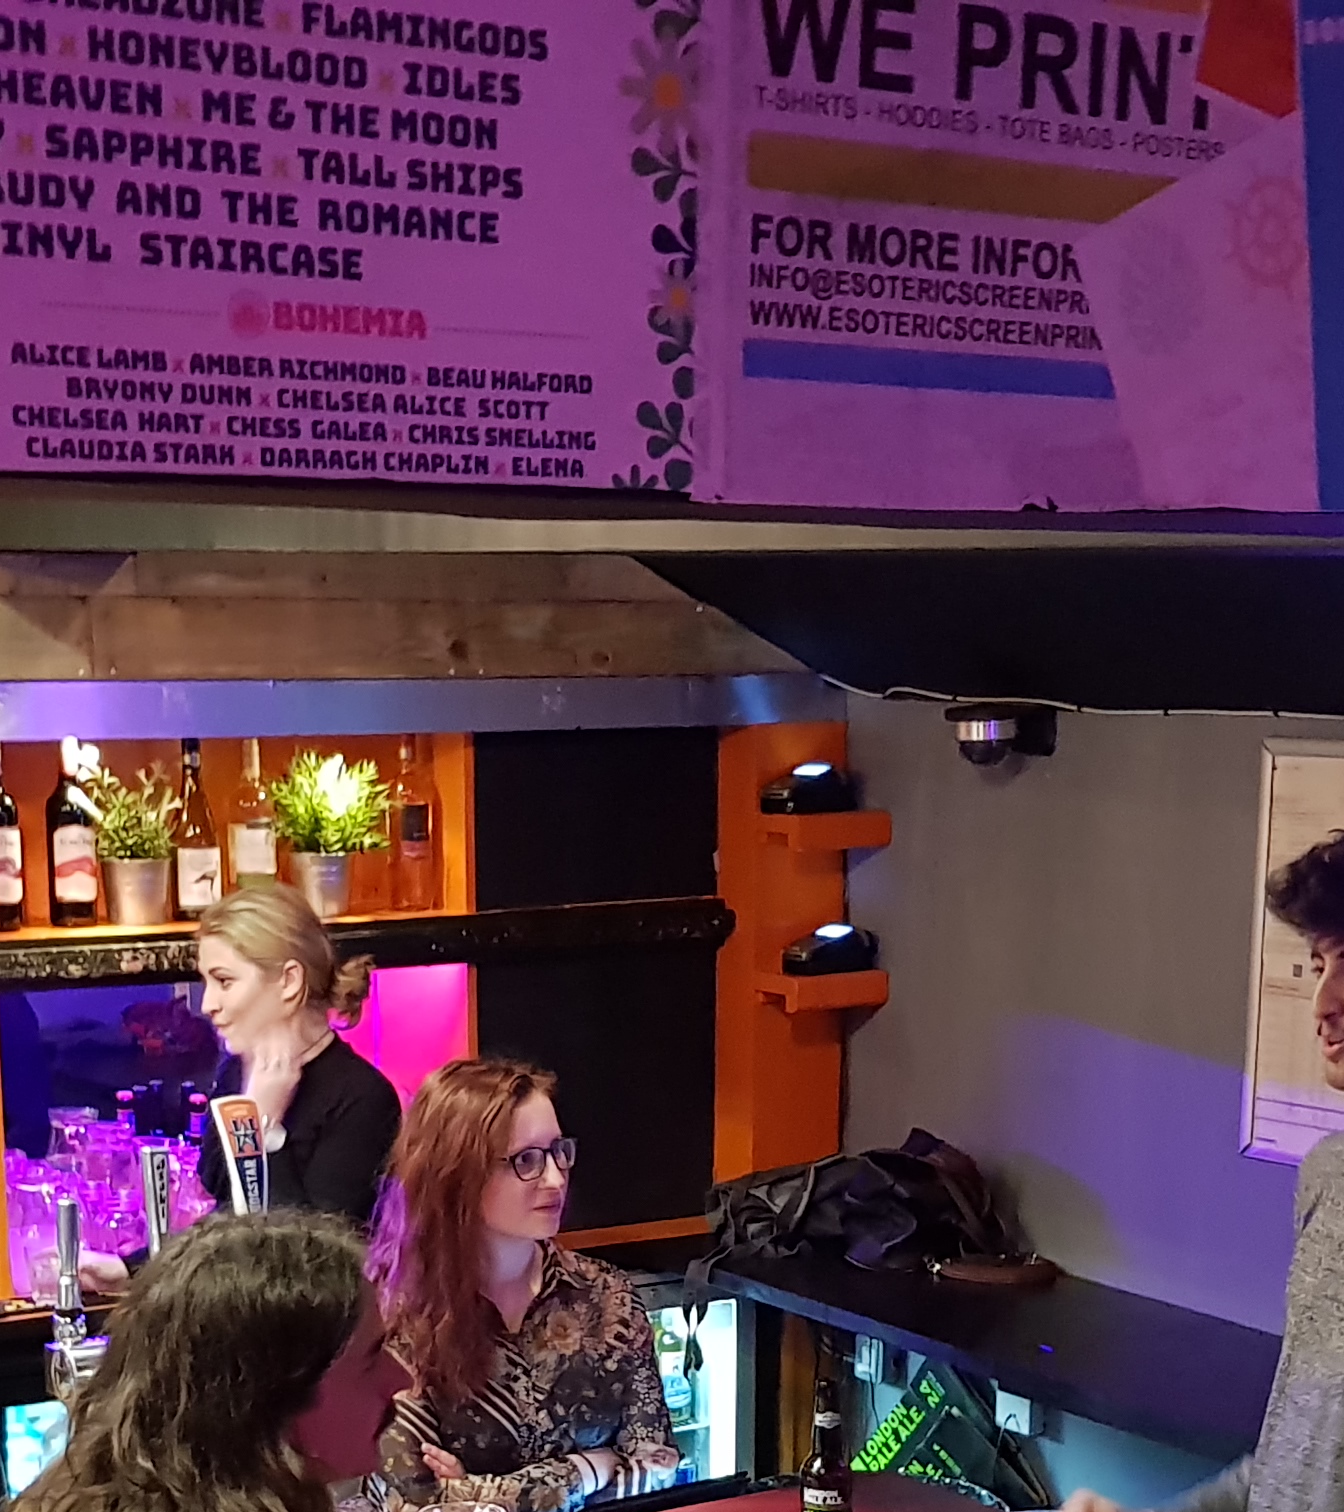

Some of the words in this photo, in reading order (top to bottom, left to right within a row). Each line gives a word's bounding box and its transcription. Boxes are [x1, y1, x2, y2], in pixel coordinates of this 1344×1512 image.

[302, 1, 550, 63] FLAMINGODS
[759, 0, 917, 94] WE
[87, 25, 368, 91] HONEYBLOOD
[402, 61, 523, 106] IDLES
[200, 92, 255, 128] ME
[267, 95, 296, 131] &
[306, 99, 380, 139] THE
[391, 111, 499, 151] MOON
[756, 84, 858, 121] T-SHIRTS
[998, 116, 1051, 144] TOTE
[1057, 123, 1113, 150] BAGS
[45, 122, 263, 178] SAPPHIRE
[296, 146, 397, 190] TALL
[406, 158, 523, 201] SHIPS
[116, 178, 202, 221] AND
[221, 190, 299, 230] THE
[318, 199, 501, 246] ROMANCE
[750, 212, 833, 261] FOR
[846, 222, 960, 272] MORE
[139, 232, 364, 283] STAIRCASE
[274, 301, 428, 341] BOHEMIA
[10, 341, 91, 370] ALICE
[96, 347, 169, 373] LAMB
[189, 352, 275, 380] AMBER
[279, 358, 407, 387] RICHMOND
[426, 366, 487, 391] BEAU
[490, 371, 593, 396] HALFORD
[66, 376, 174, 405] BRYONY
[181, 384, 253, 408] DUNN
[276, 387, 387, 415] CHELSEA
[393, 393, 467, 419] ALICE
[476, 398, 550, 422] SCOTT
[12, 405, 129, 433] CHELSEA
[137, 412, 205, 436] HART
[226, 414, 302, 440] CHESS
[310, 419, 388, 443] GALEA
[407, 423, 482, 448] CHRIS
[484, 426, 598, 451] SNELLING
[25, 436, 148, 465] CLAUDIA
[260, 445, 380, 473] DARRAGH
[382, 450, 490, 476] CHAPLIN
[510, 455, 586, 479] ELENA
[861, 1402, 908, 1464] LONDON
[869, 1434, 902, 1473] PALE
[897, 1405, 926, 1442] ALE
